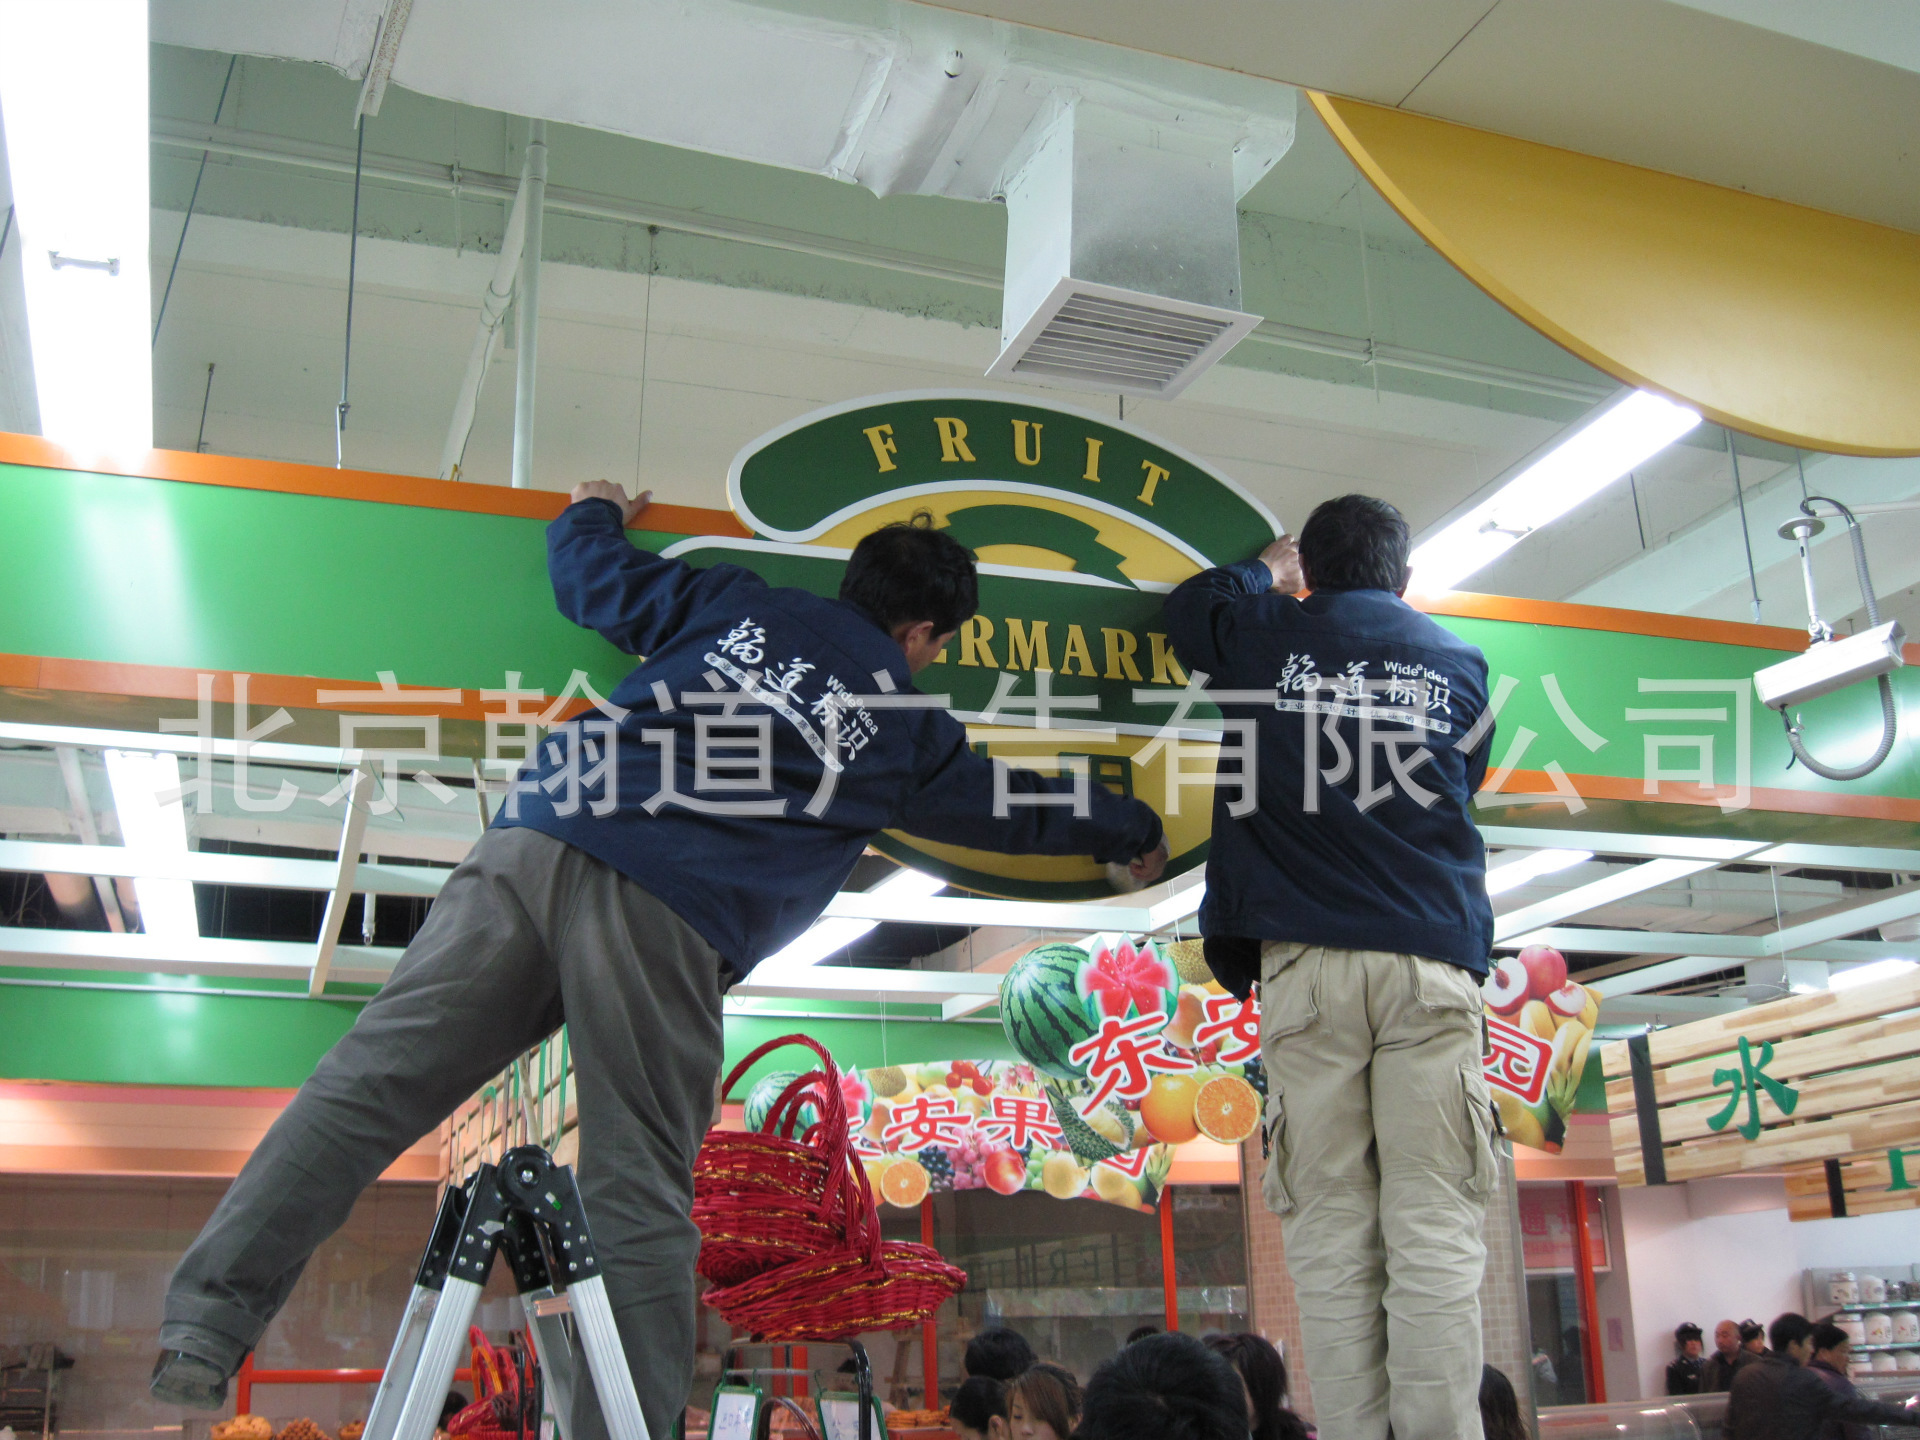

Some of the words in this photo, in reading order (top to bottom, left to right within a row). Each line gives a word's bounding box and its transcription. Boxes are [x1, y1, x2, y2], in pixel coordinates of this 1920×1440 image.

[862, 417, 1171, 506] FRUIT
[717, 617, 869, 761] 翰道标识
[1276, 653, 1451, 714] 翰道标识
[1706, 1035, 1799, 1141] 水
